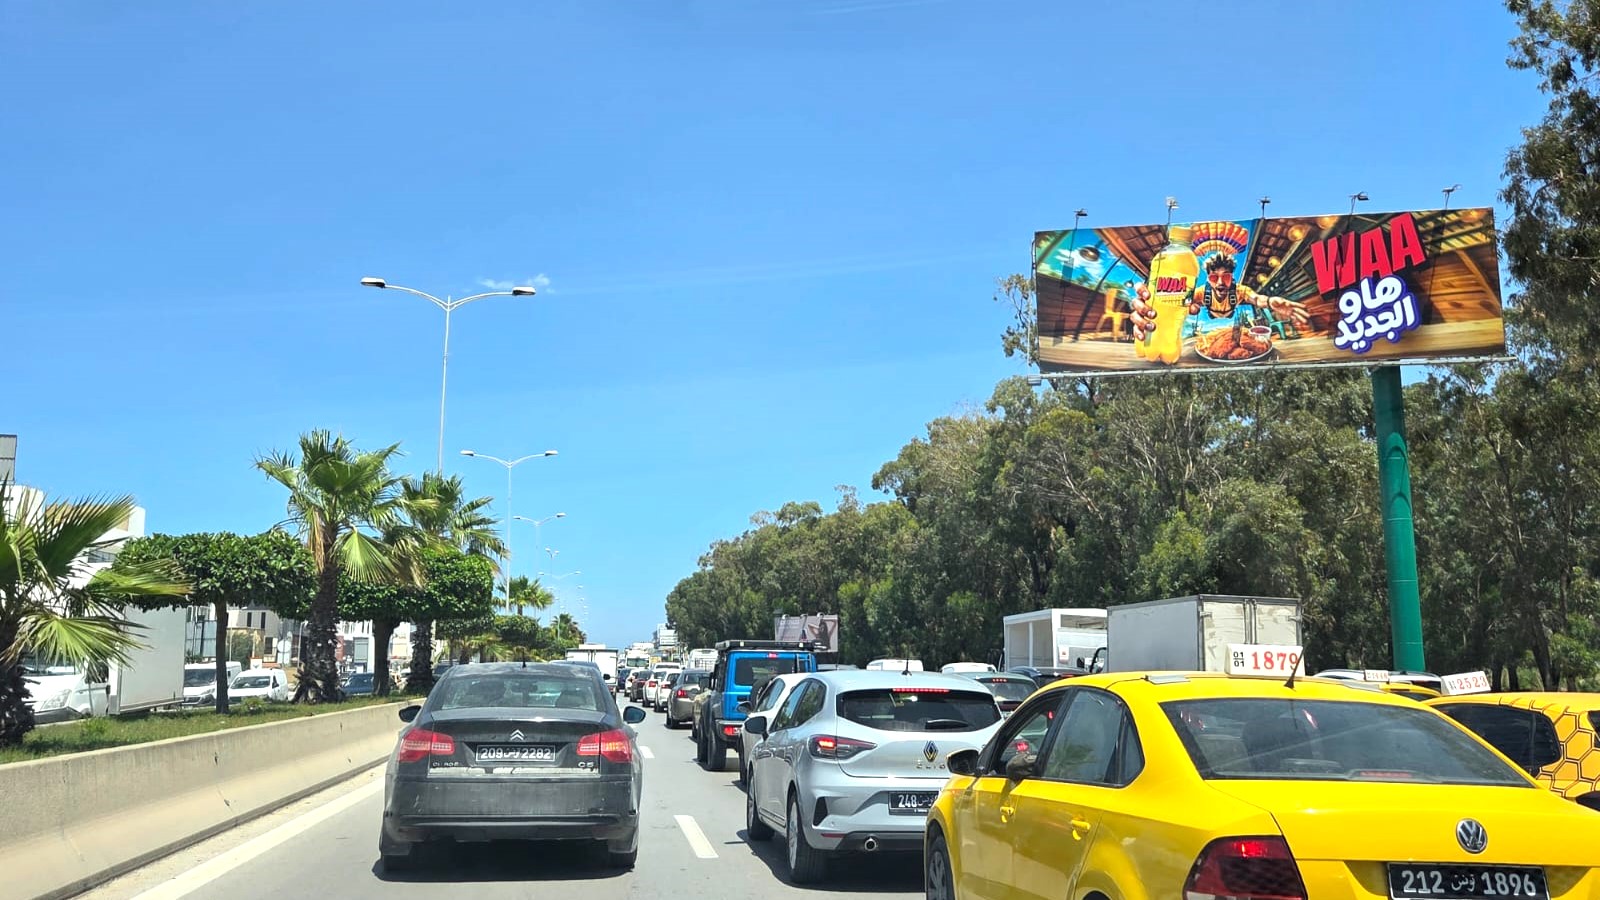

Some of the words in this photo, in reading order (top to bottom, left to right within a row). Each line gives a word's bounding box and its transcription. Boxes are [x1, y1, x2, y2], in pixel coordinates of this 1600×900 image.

[1310, 211, 1426, 296] WAA
[1156, 276, 1187, 293] WAA
[1338, 276, 1403, 324] هاو
[1334, 294, 1416, 351] الجديد
[1233, 651, 1244, 659] 01
[1251, 650, 1300, 671] 1879
[480, 747, 504, 759] 209
[521, 748, 552, 760] 2282
[898, 794, 917, 808] 248
[1401, 869, 1445, 894] 212
[1480, 871, 1537, 897] 1896
